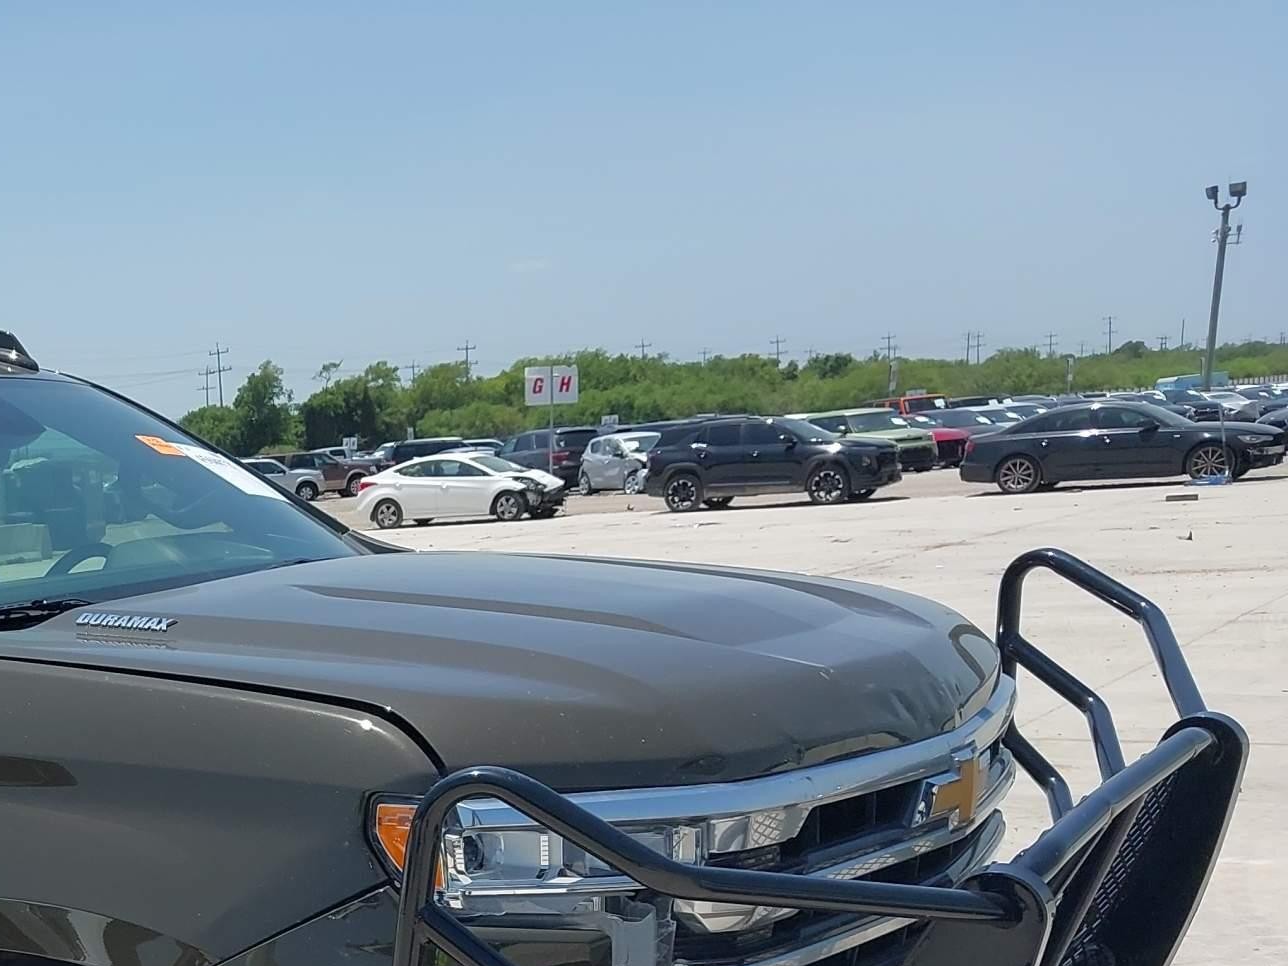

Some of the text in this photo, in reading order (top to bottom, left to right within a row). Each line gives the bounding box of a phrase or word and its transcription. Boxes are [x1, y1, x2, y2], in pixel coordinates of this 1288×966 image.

[532, 377, 545, 394] G
[558, 375, 572, 393] H
[75, 612, 173, 631] DURAMAX
